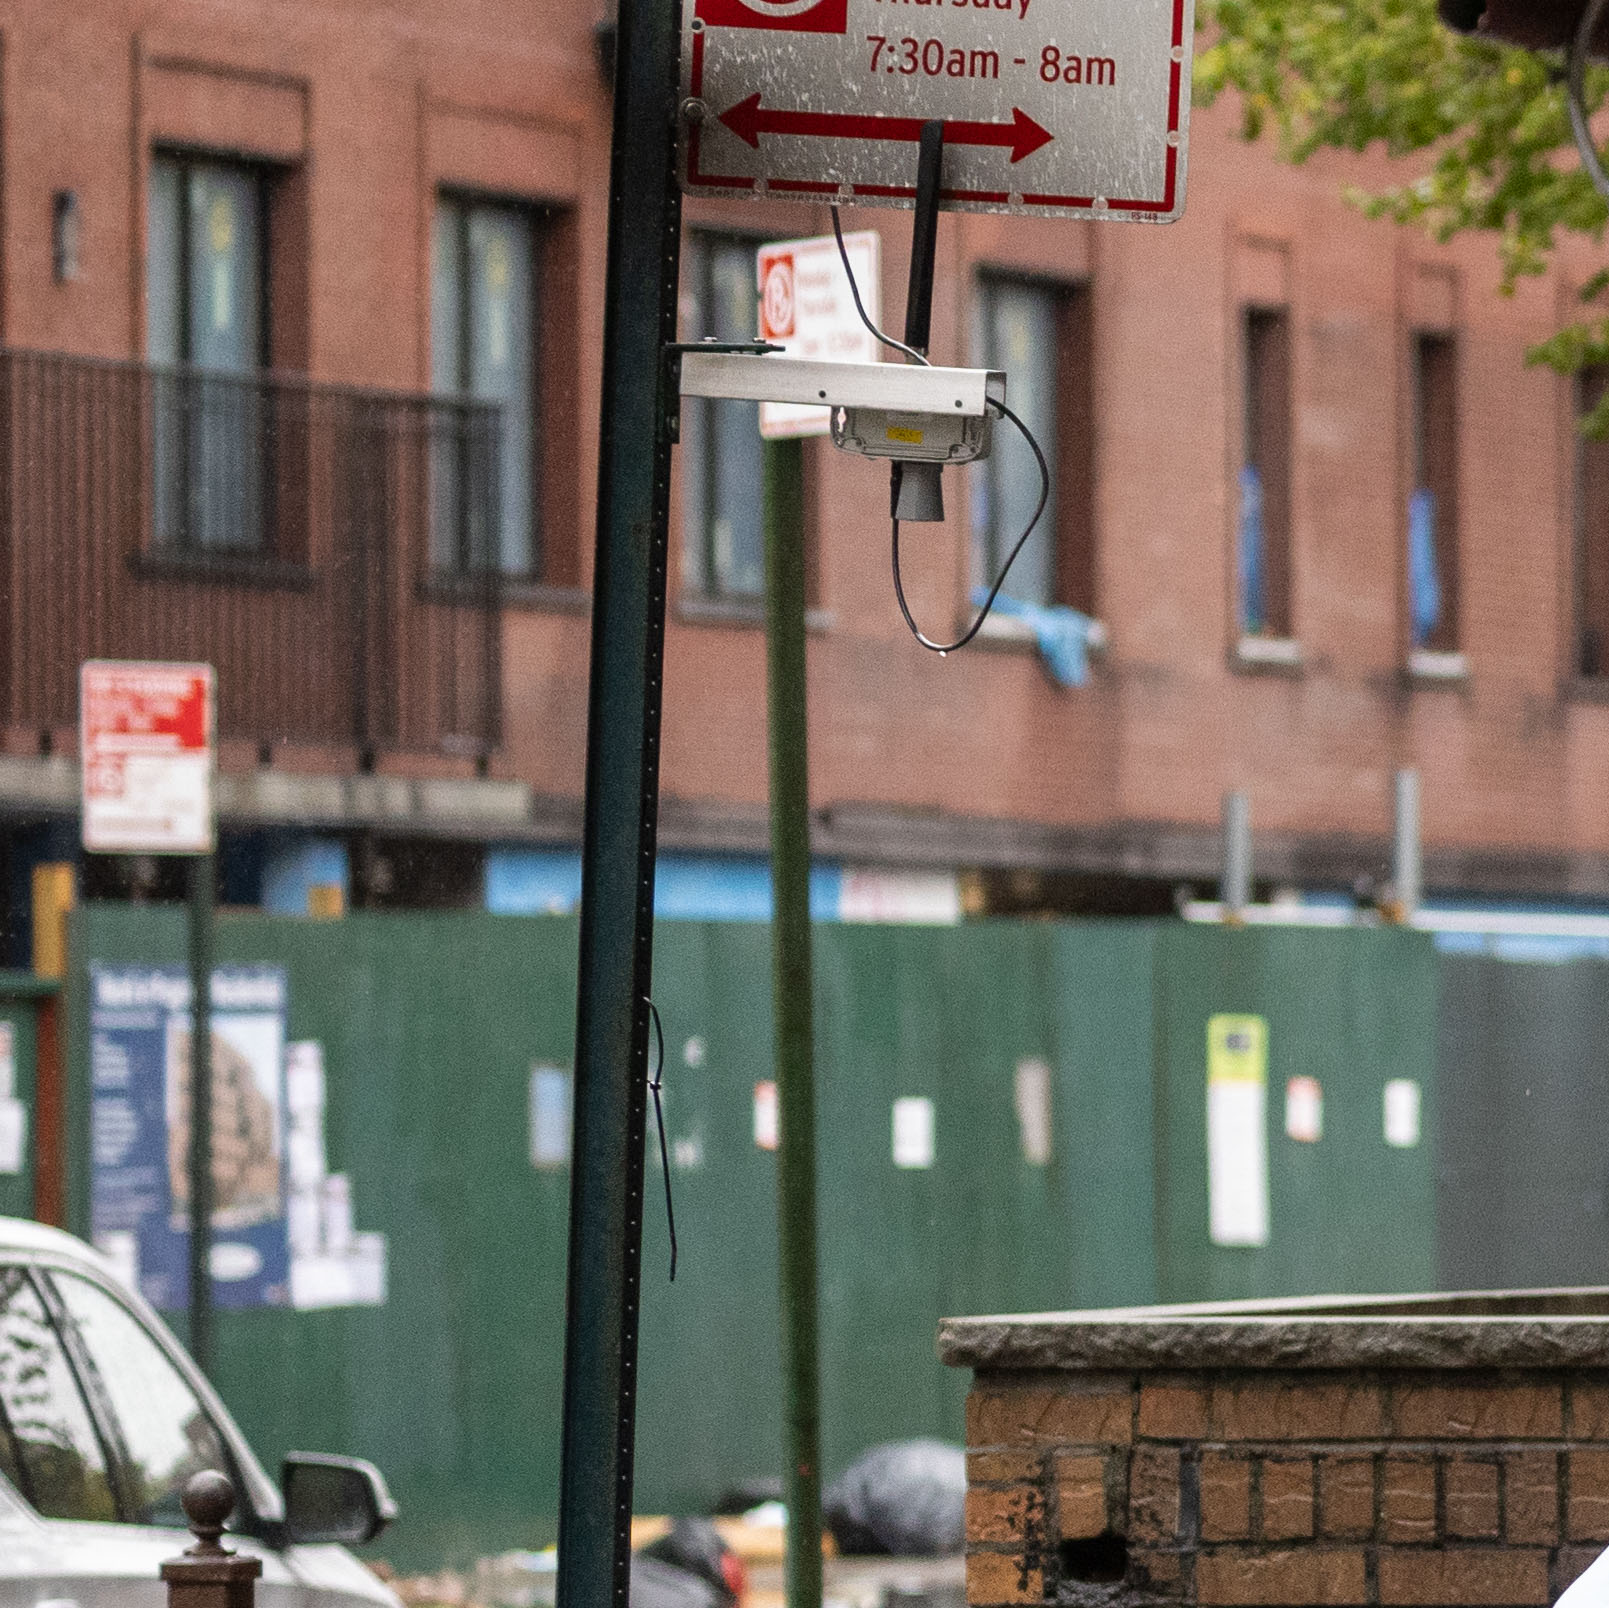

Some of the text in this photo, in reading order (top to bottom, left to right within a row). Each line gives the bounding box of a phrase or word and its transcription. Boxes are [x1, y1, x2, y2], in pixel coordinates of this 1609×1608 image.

[866, 35, 1116, 86] 7:30am - 8am
